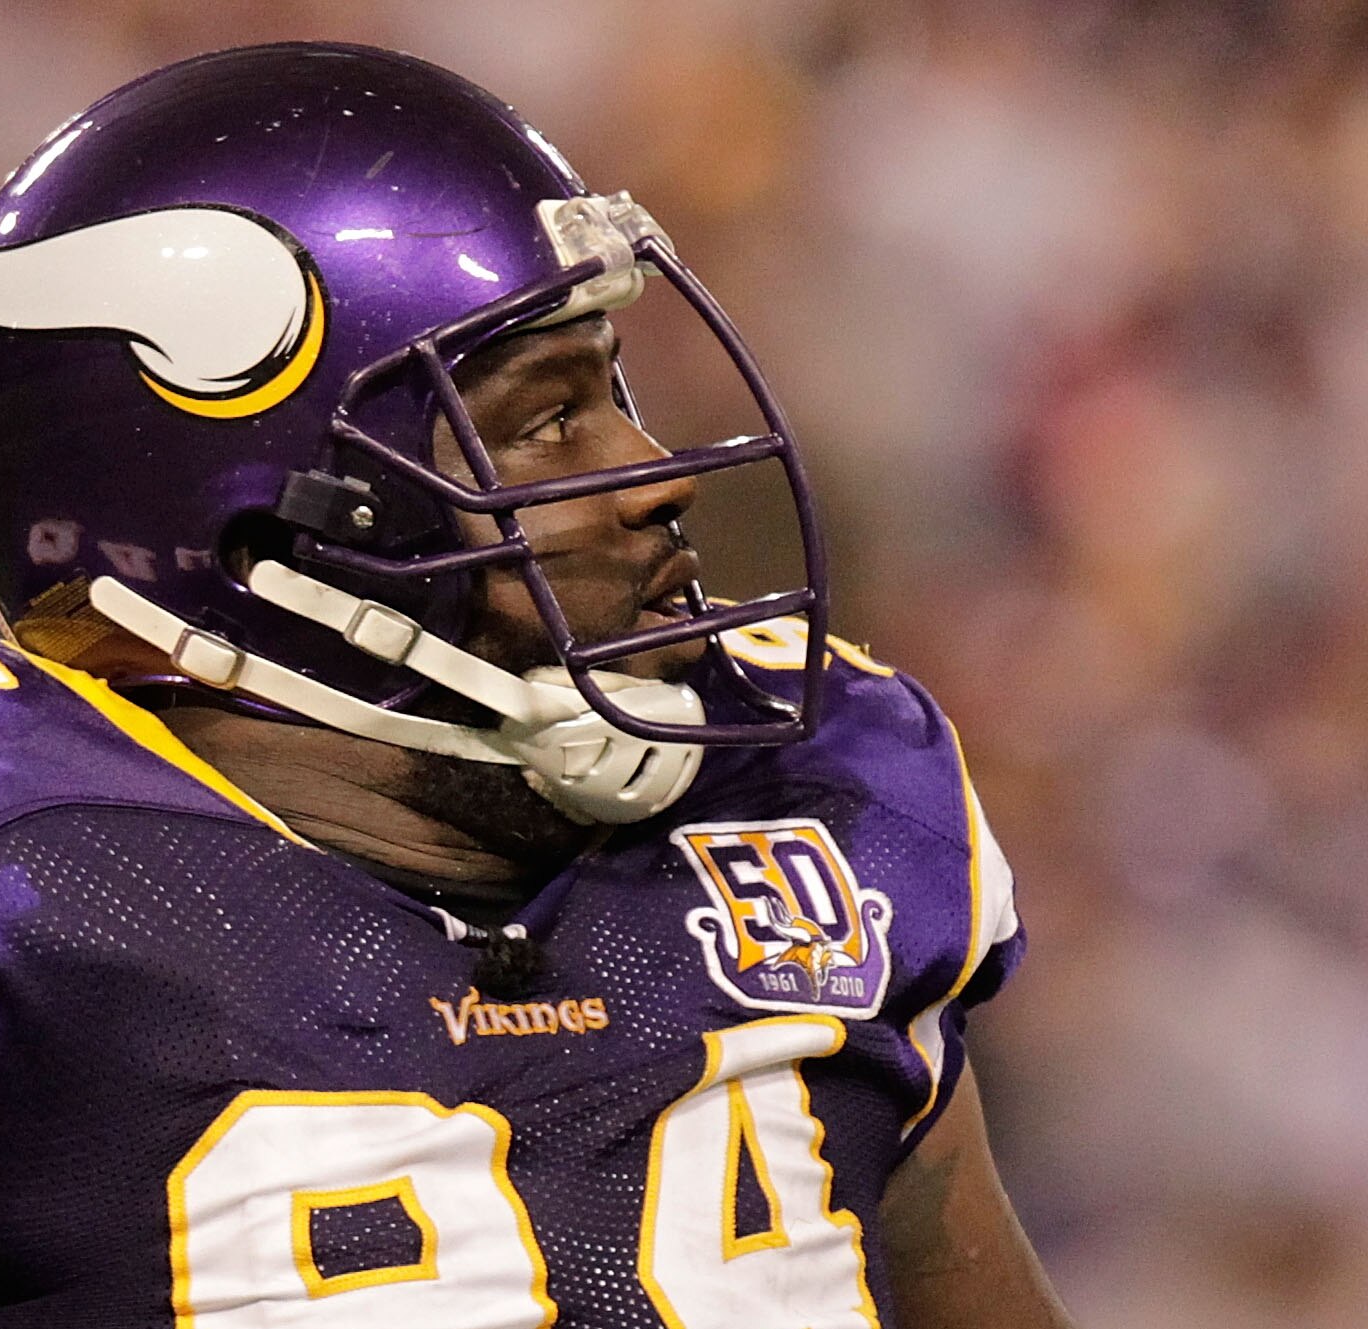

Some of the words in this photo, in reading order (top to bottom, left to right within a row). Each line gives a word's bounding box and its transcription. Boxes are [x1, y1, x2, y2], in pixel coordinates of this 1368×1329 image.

[705, 838, 851, 942] 50
[758, 972, 800, 992] 1961
[830, 976, 865, 996] 2010
